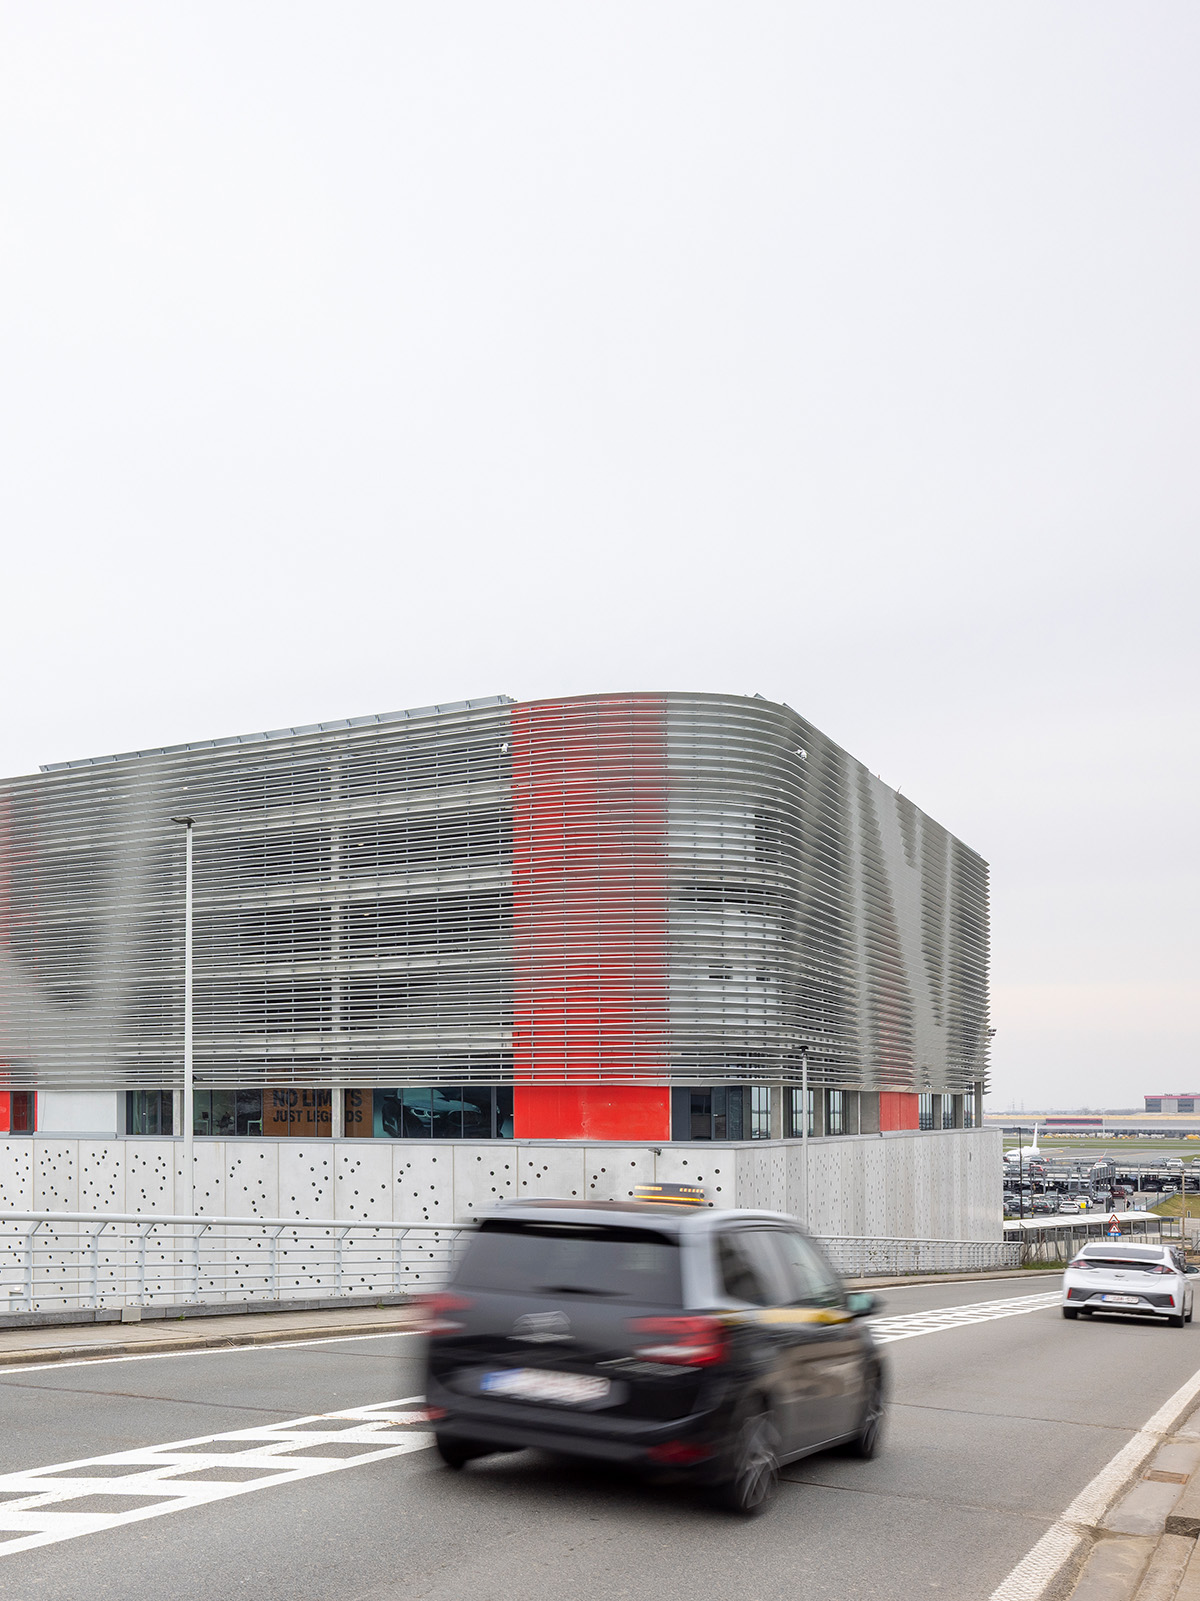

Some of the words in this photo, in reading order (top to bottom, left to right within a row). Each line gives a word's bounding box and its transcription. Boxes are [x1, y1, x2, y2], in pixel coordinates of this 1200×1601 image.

[273, 1089, 297, 1107] NO
[302, 1089, 362, 1107] LIMS
[273, 1110, 303, 1122] JUST
[307, 1110, 362, 1122] LEGDS
